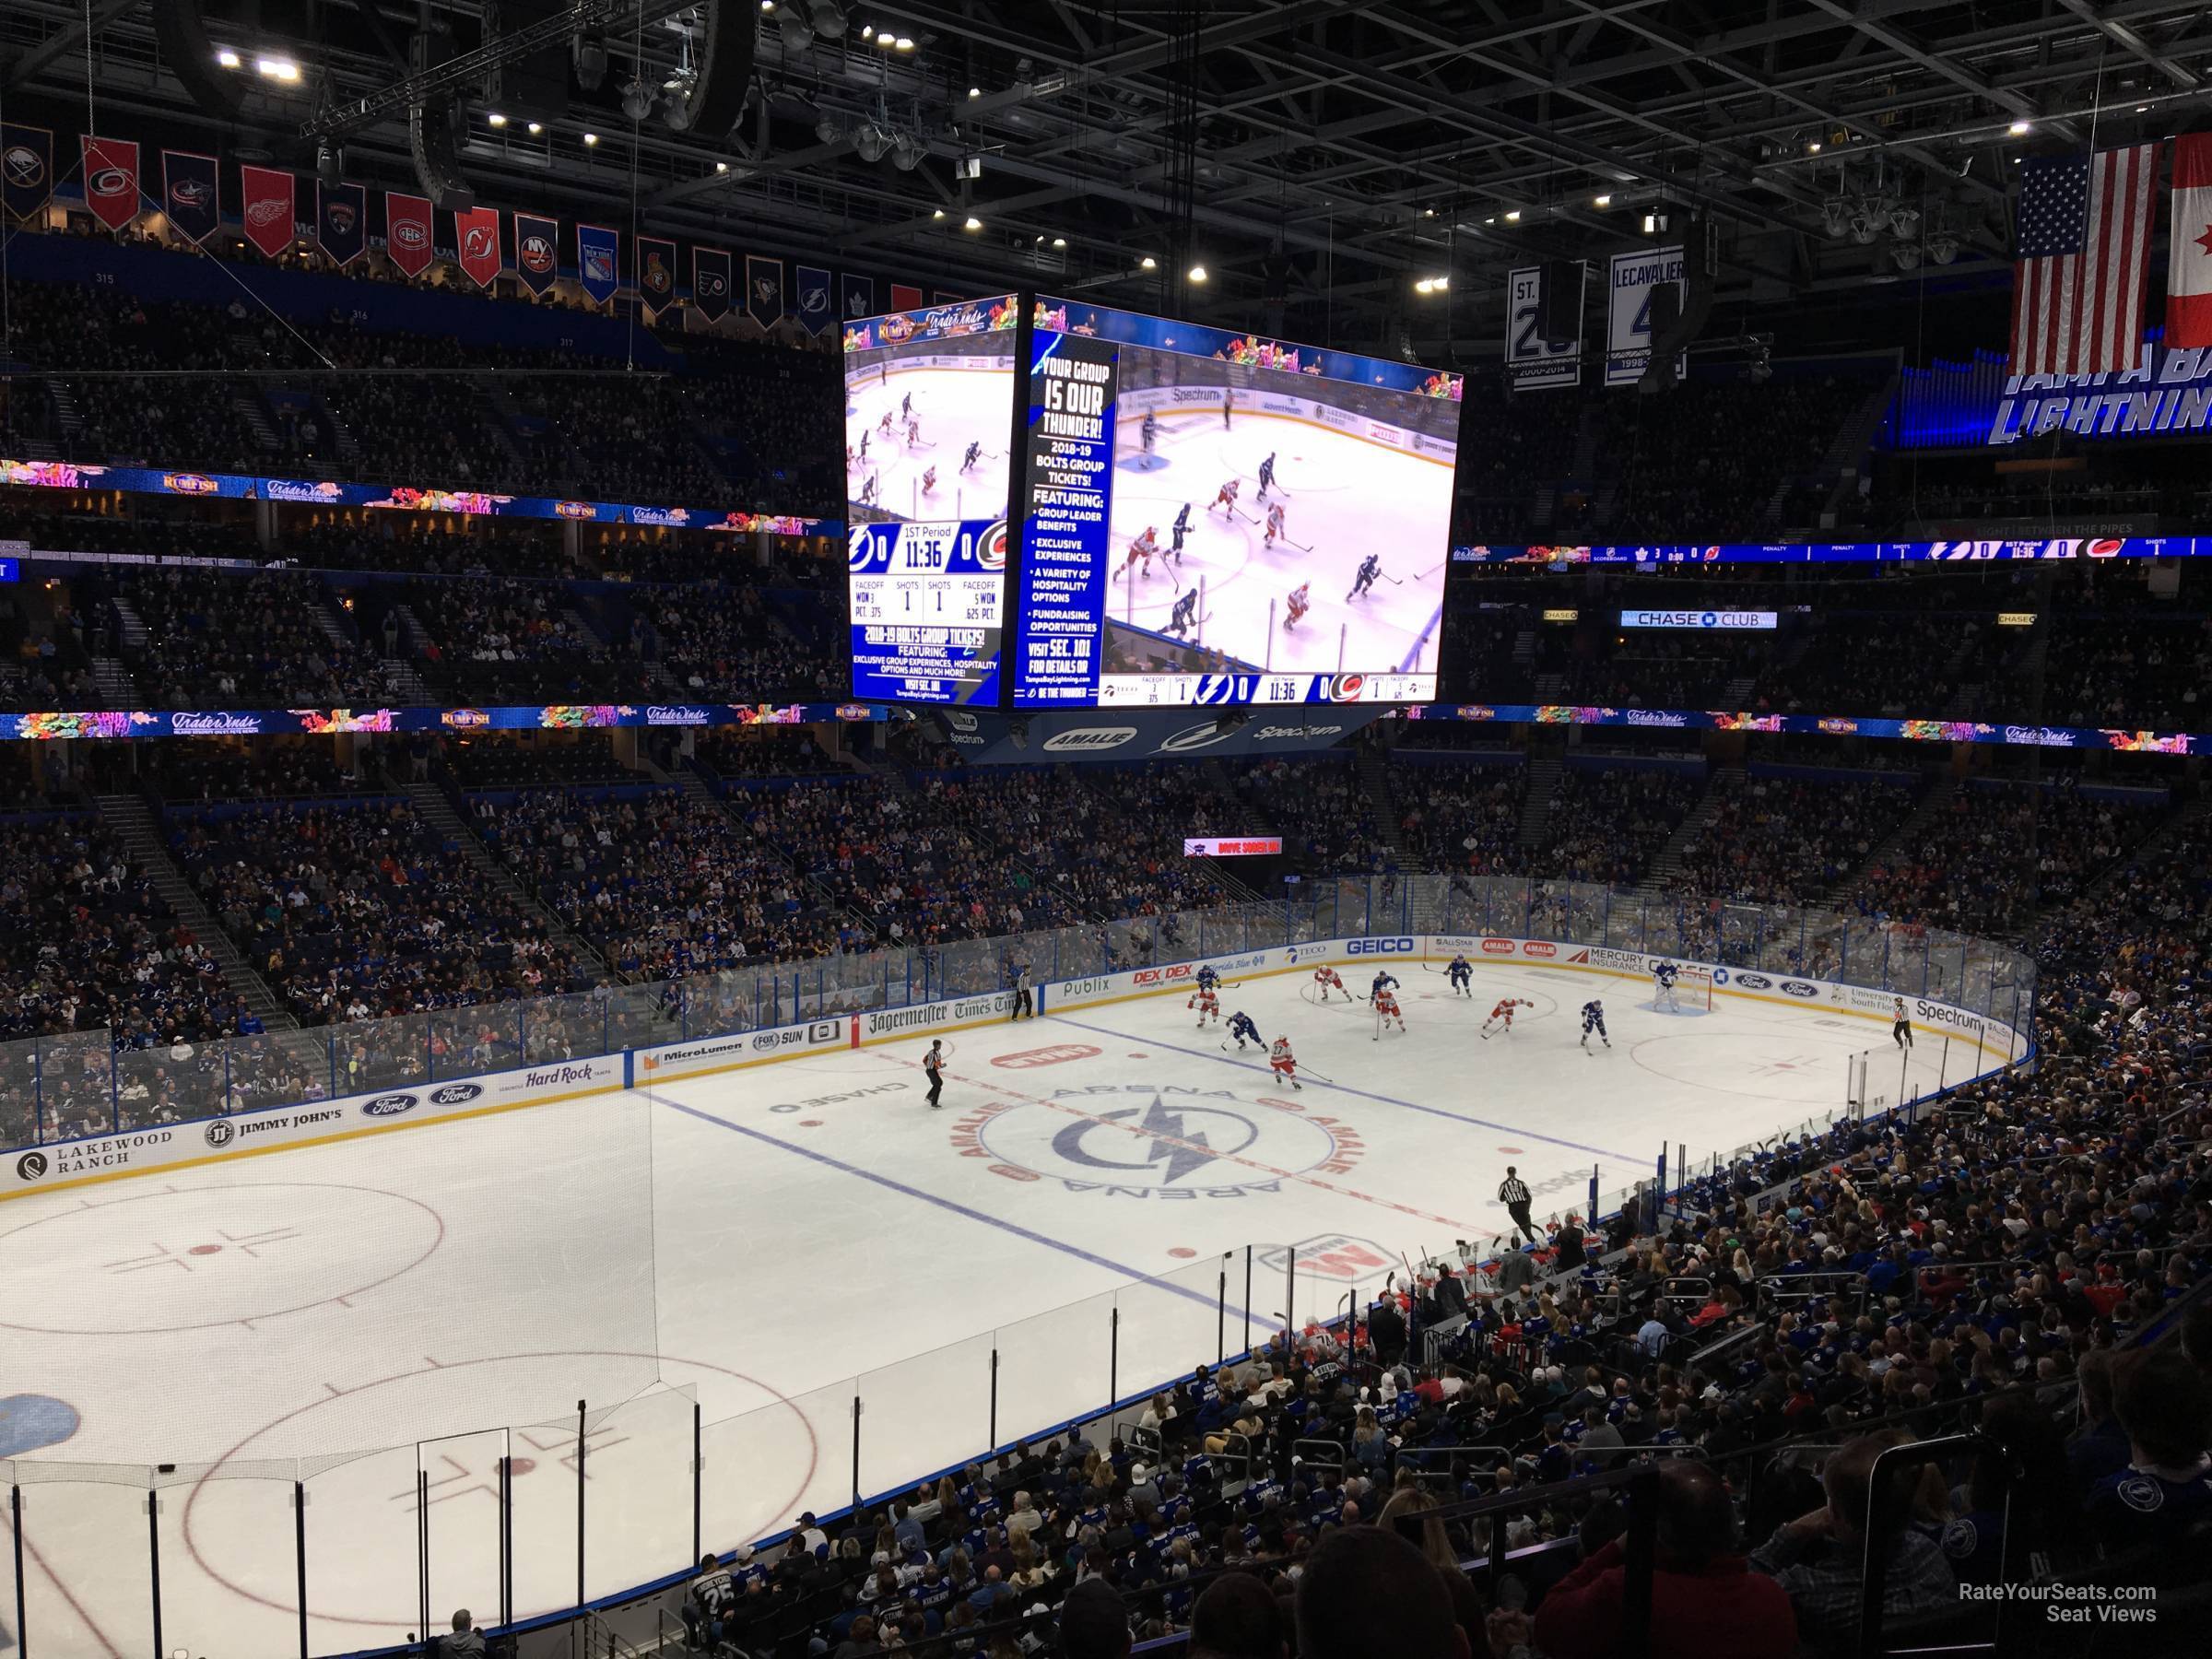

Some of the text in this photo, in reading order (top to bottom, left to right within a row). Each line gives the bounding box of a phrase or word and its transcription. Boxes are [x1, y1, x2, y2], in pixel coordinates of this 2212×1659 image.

[1517, 280, 1535, 300] ST.
[1042, 357, 1110, 383] YOUR GROUP
[1044, 379, 1063, 411] IS
[1066, 382, 1104, 416] OUR
[1042, 412, 1103, 439] THUNDER!
[1051, 442, 1092, 457] 2018-19
[1036, 454, 1105, 472] BOLTS GROUP
[1048, 472, 1091, 487] TICKETS!
[1033, 489, 1104, 508] FEATURING:
[1038, 508, 1102, 522] GROUP LEADER
[904, 526, 952, 538] 1ST Period
[1036, 521, 1077, 532] BENEFITS
[2072, 525, 2097, 535] THE
[2100, 524, 2134, 534] PIPES
[877, 535, 887, 561] 0
[961, 534, 972, 561] 0
[1036, 538, 1082, 550] EXCLUSIVE
[1981, 544, 1991, 558] 0
[2058, 542, 2067, 557] 0
[905, 541, 942, 568] 11:36
[1035, 551, 1091, 563] EXPERIENCES
[1034, 569, 1091, 579] A VARIETY OF
[855, 582, 919, 590] FACEOFF SHOTS
[928, 582, 995, 590] SHOTS FACEOFF
[1032, 581, 1088, 592] HOSPITALITY
[856, 593, 869, 603] WON
[905, 591, 910, 611] 1
[937, 591, 942, 611] 1
[980, 593, 995, 604] WON
[1032, 594, 1070, 604] OPTIONS
[1032, 610, 1090, 620] FUNDRAISING
[1638, 612, 1760, 626] CHASE CLUB
[1030, 622, 1098, 633] OPPORTUNITIES
[865, 627, 985, 645] 2018-19 BOLTS GROUP TICKETS!
[898, 646, 948, 658] FEATURING:
[1029, 639, 1091, 657] VISIT SEC. 101
[853, 655, 886, 665] EXCLUSIVE
[887, 657, 909, 665] GROUP
[954, 661, 997, 670] HOSPITALITY
[880, 665, 909, 674] OPTIONS
[1029, 660, 1088, 674] FOR DETAILS OR
[905, 679, 919, 690] VISIT
[1025, 676, 1091, 685] TampaBayLightning.com
[896, 690, 949, 700] TampaBayLightning.com
[1180, 684, 1184, 700] 1
[1238, 677, 1249, 700] 0
[1269, 682, 1296, 700] 11:36
[1319, 677, 1329, 700] 0
[441, 712, 490, 724] RUMFISH
[647, 706, 711, 720] TradeWinds
[835, 706, 870, 717] RUMFISH
[1626, 710, 1688, 723] TradeWinds
[172, 712, 261, 728] TradeWinds
[950, 732, 982, 745] Spectrum
[1051, 733, 1132, 745] AMALIE
[2006, 725, 2077, 741] TradeWinds
[1300, 945, 1326, 956] TECO
[1347, 937, 1415, 955] GEICO
[1591, 948, 1644, 964] MERCURY
[1590, 958, 1645, 973] INSURANCE
[1134, 965, 1194, 984] DEX DEX
[1741, 974, 1768, 990] Ford
[1064, 978, 1110, 996] Publix
[1788, 982, 1813, 996] Ford
[1852, 988, 1891, 1002] University
[1852, 997, 1876, 1008] South
[955, 1002, 992, 1018] Times
[1917, 1000, 1981, 1031] Spectrum
[758, 1030, 803, 1045] FOX SUN
[664, 1042, 742, 1062] MicroLumen
[525, 1063, 592, 1088] Hard Rock
[439, 1086, 474, 1105] Ford
[1052, 1084, 1238, 1100] ARENA
[371, 1098, 408, 1116] Ford
[240, 1117, 289, 1137] JIMMY
[949, 1100, 1006, 1159] AMALIE
[57, 1131, 173, 1160] LAKEWOOD
[1310, 1115, 1366, 1175] AMALIE
[58, 1151, 130, 1174] RANCH
[1063, 1180, 1283, 1200] ARENA
